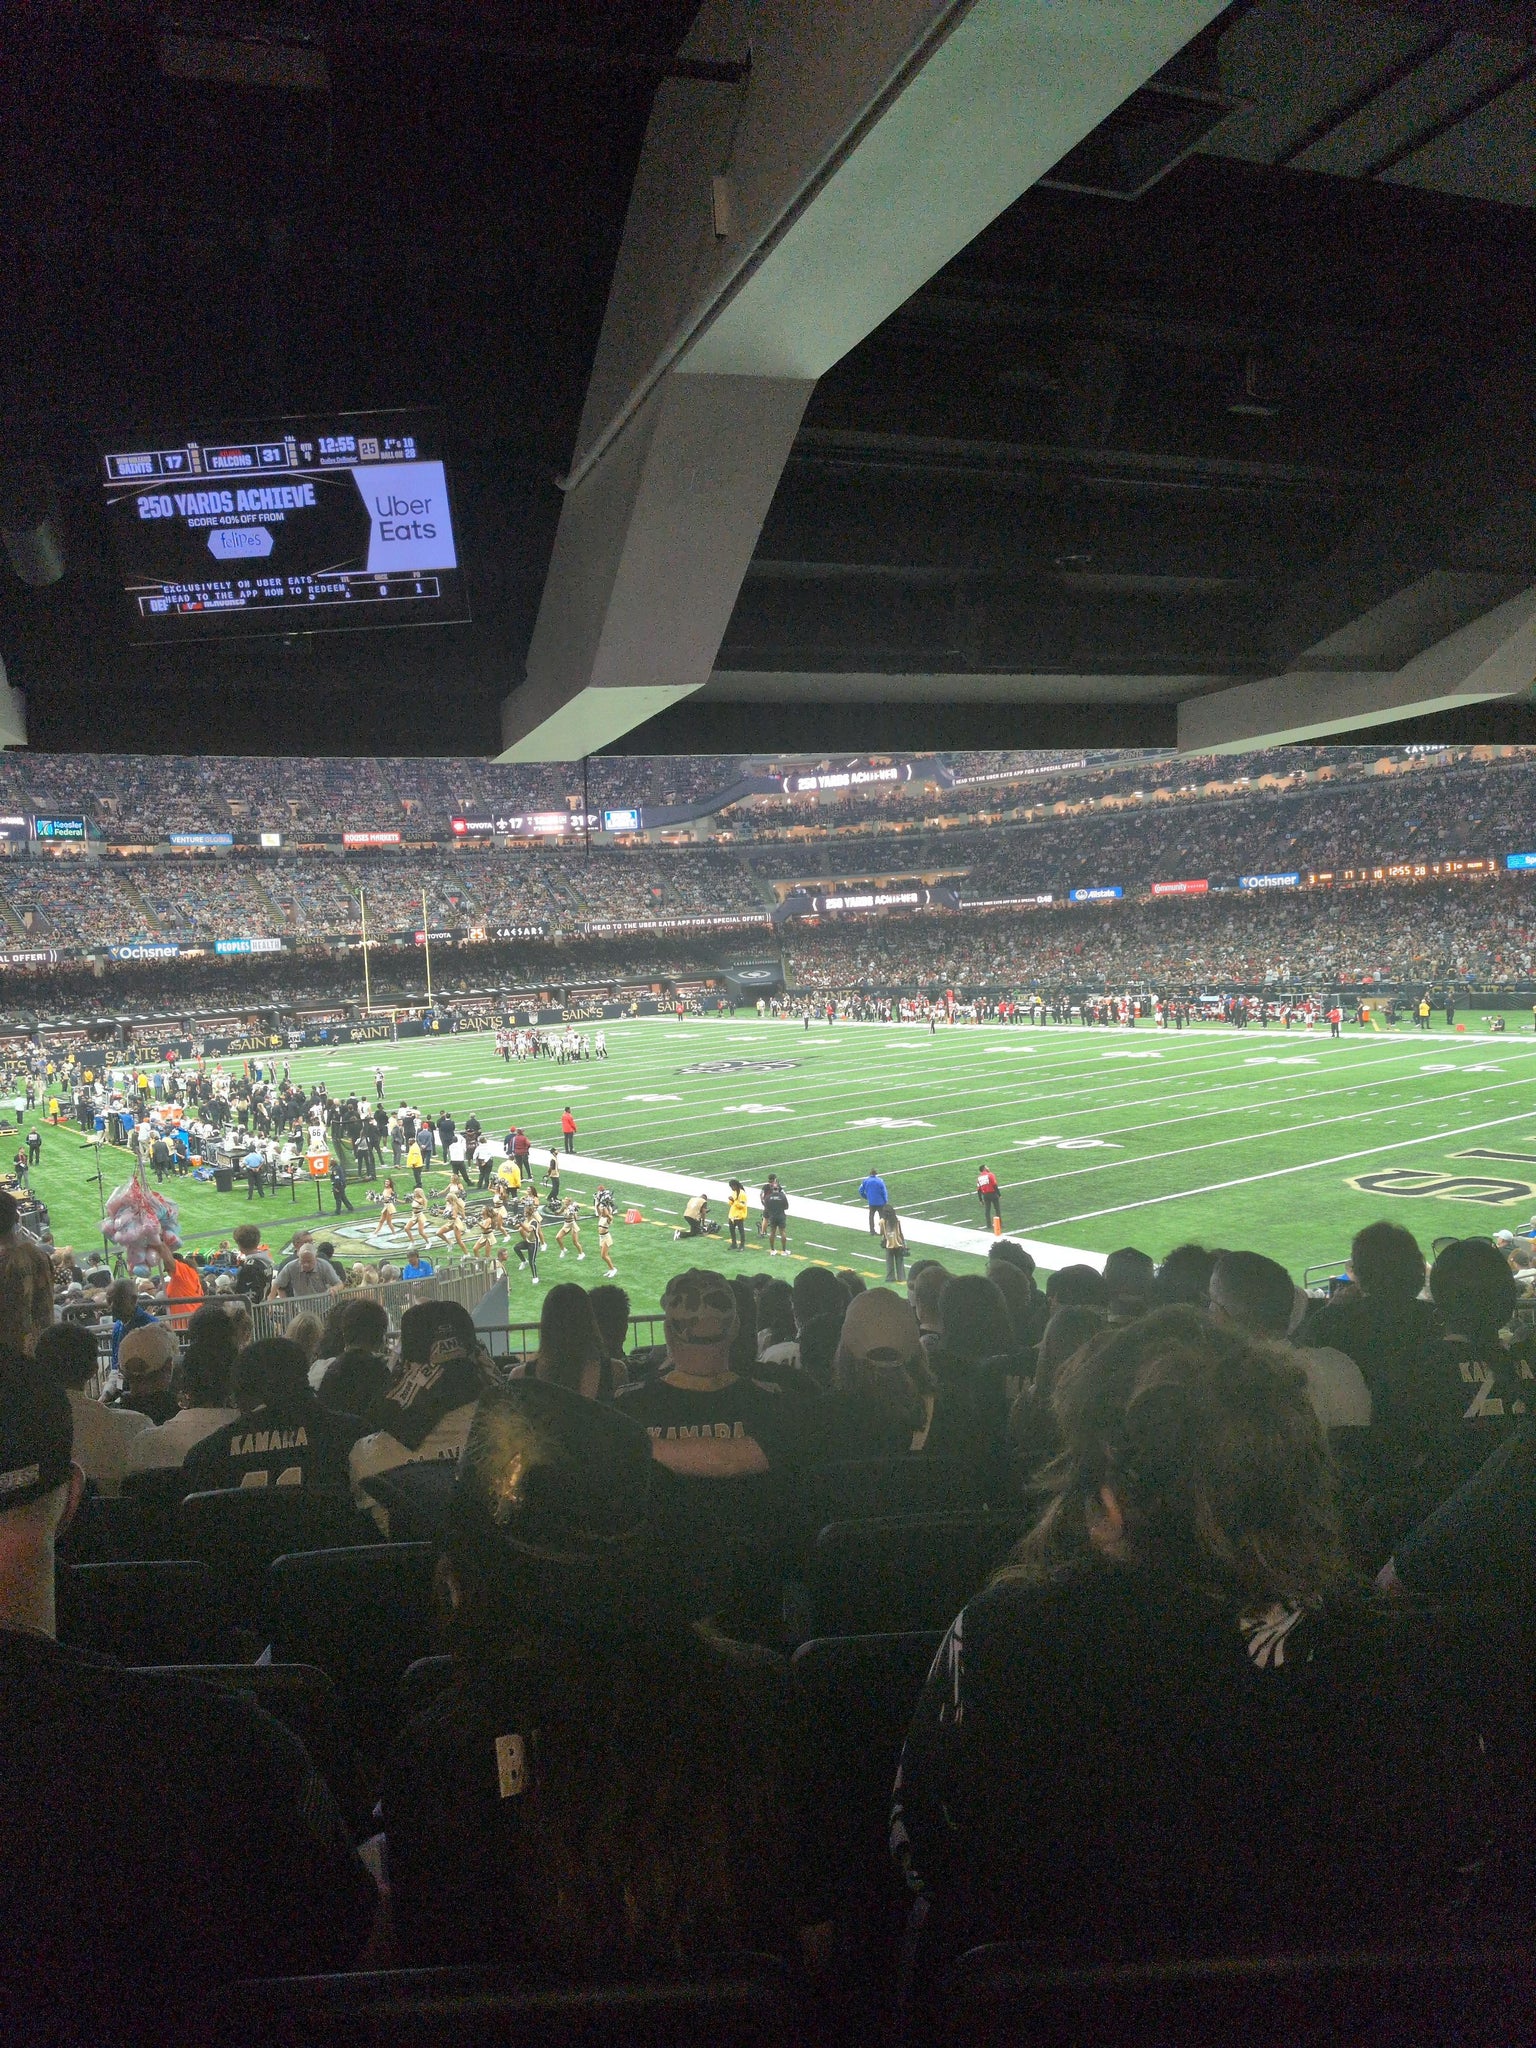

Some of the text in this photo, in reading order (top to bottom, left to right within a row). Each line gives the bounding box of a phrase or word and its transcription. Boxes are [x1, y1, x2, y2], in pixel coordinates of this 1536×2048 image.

[318, 436, 356, 453] 12:55
[361, 442, 376, 455] 25
[402, 437, 414, 448] 10
[165, 455, 182, 469] 17
[212, 455, 251, 468] FALCONS
[262, 449, 281, 462] 31
[118, 462, 153, 475] SAINTS
[137, 483, 317, 519] 250 YARDS ACHIEVE
[375, 495, 432, 517] Uber
[188, 512, 285, 527] SCORE 40% OFF FROM
[379, 520, 437, 542] Eats
[163, 575, 317, 594] EXCLUSIVELY ON UBER EATS.
[415, 583, 423, 594] 1
[165, 583, 350, 604] HEAD TO THE APP NOW TO REDEEM.
[1040, 765, 1061, 773] SPECIAL
[818, 773, 850, 788] YARDS
[466, 822, 493, 830] TOYOTA
[508, 818, 523, 830] 17
[570, 815, 584, 827] 31
[54, 828, 83, 836] Federal
[130, 835, 160, 843] SAINTS
[171, 836, 204, 844] VENTURE
[1388, 865, 1411, 876] 12:55
[1414, 866, 1426, 876] 28
[1154, 882, 1187, 894] Community
[1248, 875, 1297, 888] Ochsner
[470, 928, 484, 939] 25
[496, 926, 544, 937] CAESARS
[551, 923, 575, 931] SAINTS
[295, 936, 326, 945] SAINTS
[427, 932, 451, 940] TOYOTA
[217, 939, 281, 952] PEOPLES HEALTH
[12, 953, 46, 962] OFFER!
[119, 946, 178, 959] Ochsner
[153, 1003, 292, 1018] SUPERDOME
[459, 1015, 503, 1031] SAINTS
[312, 1128, 321, 1137] 66
[313, 1158, 324, 1170] G
[229, 1426, 308, 1456] KAMARA
